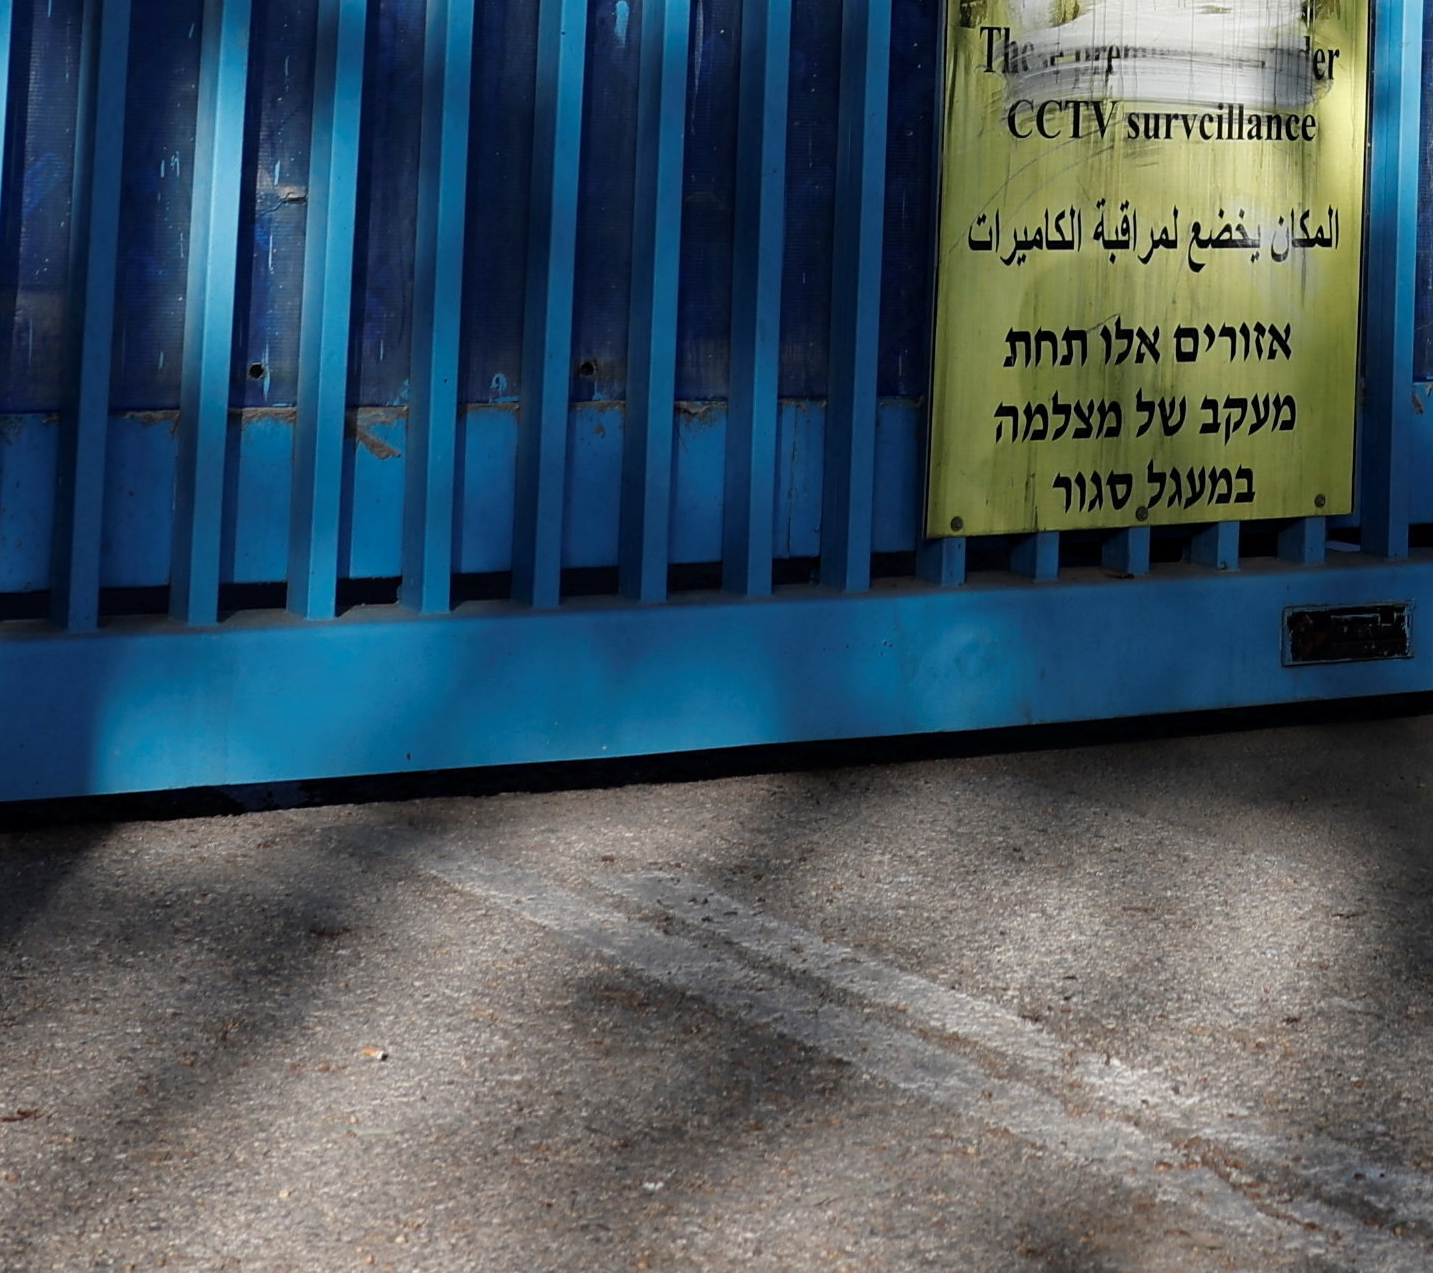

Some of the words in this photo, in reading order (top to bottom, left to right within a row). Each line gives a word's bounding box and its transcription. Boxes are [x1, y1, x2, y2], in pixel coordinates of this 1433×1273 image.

[1007, 98, 1119, 140] CCTV
[967, 204, 1082, 267] الكاميرات
[1092, 197, 1179, 265] لمراقبة
[1188, 205, 1261, 274] يخضع
[1270, 204, 1340, 263] المكان
[1002, 325, 1088, 368] תחת
[1099, 315, 1161, 366] אלו
[1172, 321, 1293, 363] אזורים
[993, 390, 1123, 444] מצלמה
[1135, 387, 1187, 439] של
[1198, 391, 1297, 446] מעקב
[1052, 469, 1134, 514] סגור
[1146, 458, 1256, 511] במעגל
